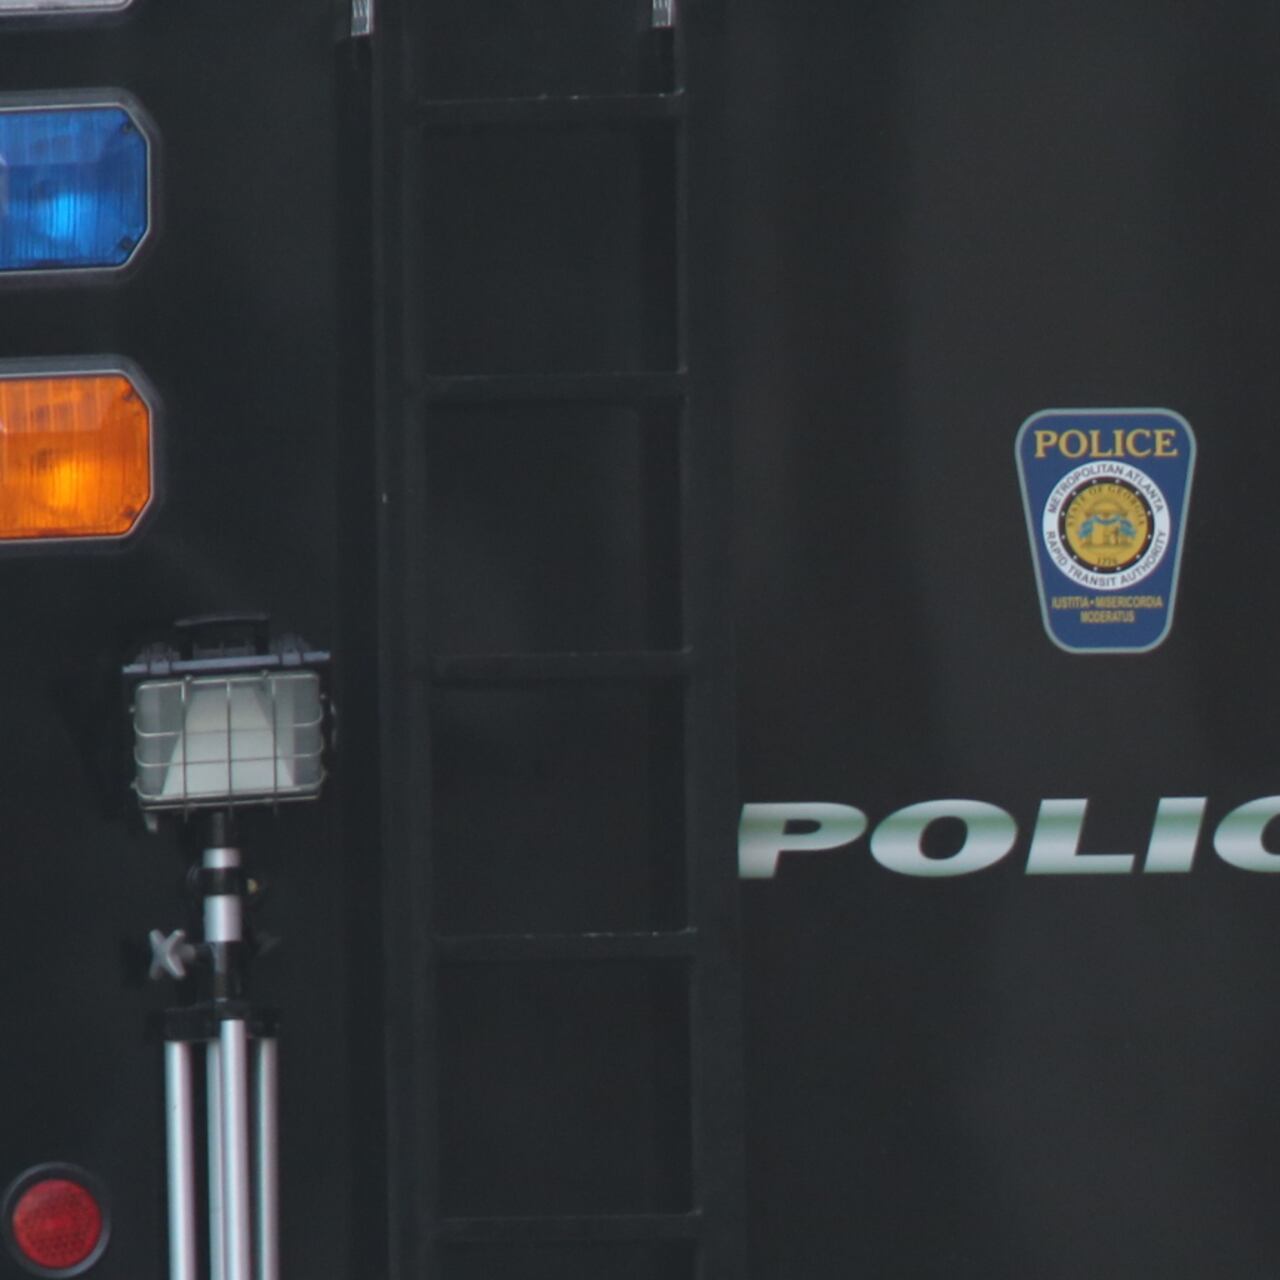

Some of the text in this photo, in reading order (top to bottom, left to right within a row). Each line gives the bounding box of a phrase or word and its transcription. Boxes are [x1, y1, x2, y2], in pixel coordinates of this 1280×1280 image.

[1033, 429, 1178, 458] POLICE
[1048, 464, 1164, 514] METROPOLITAN ATLANTA
[1046, 530, 1167, 587] RAPID TRANSIT AUTHORITY
